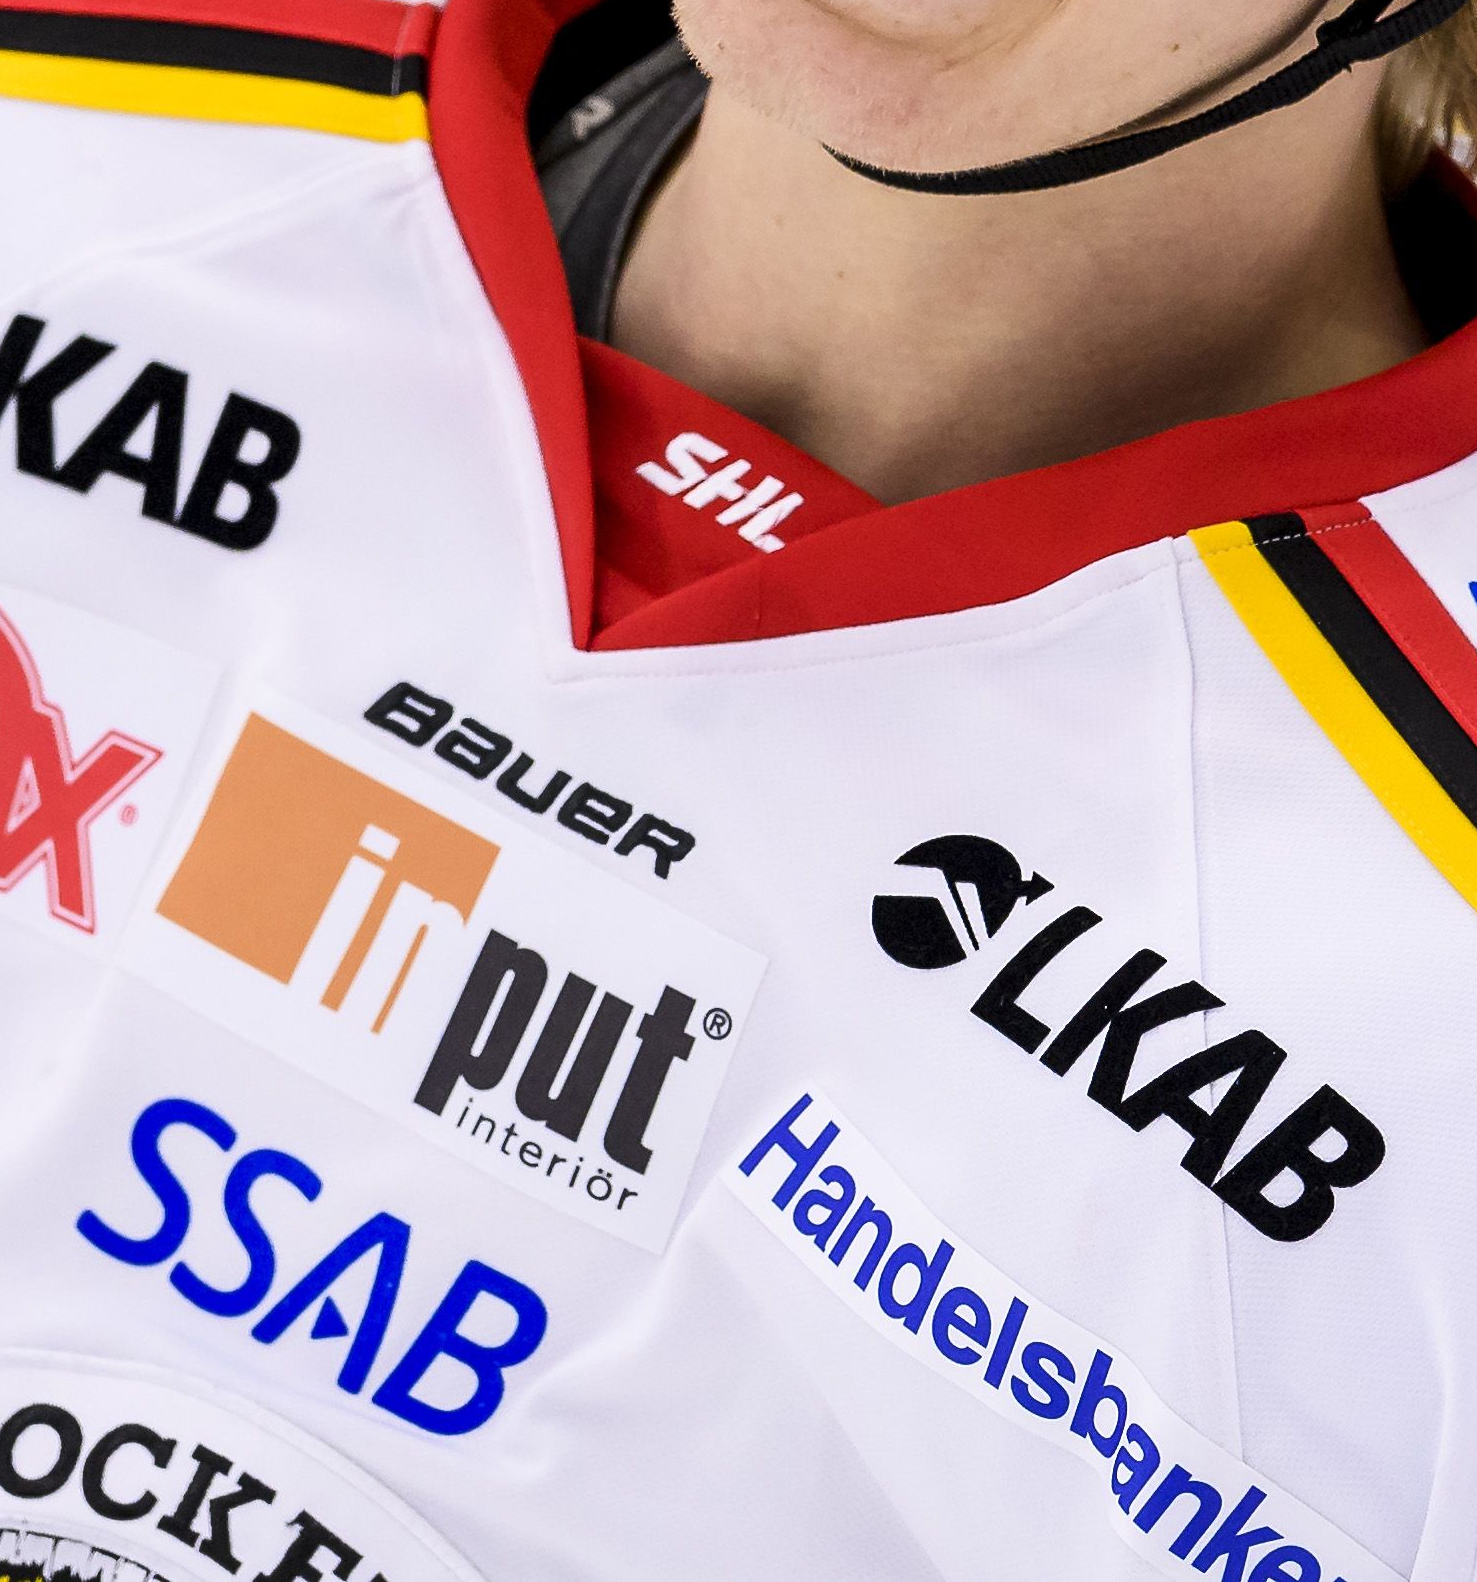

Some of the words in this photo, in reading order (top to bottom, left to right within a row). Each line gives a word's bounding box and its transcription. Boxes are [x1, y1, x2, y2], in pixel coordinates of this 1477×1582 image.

[635, 431, 804, 554] SHL
[456, 1098, 640, 1212] interiör
[970, 905, 1386, 1243] LKAB
[76, 1097, 549, 1436] SSAB
[737, 1092, 1348, 1582] Handelsbank
